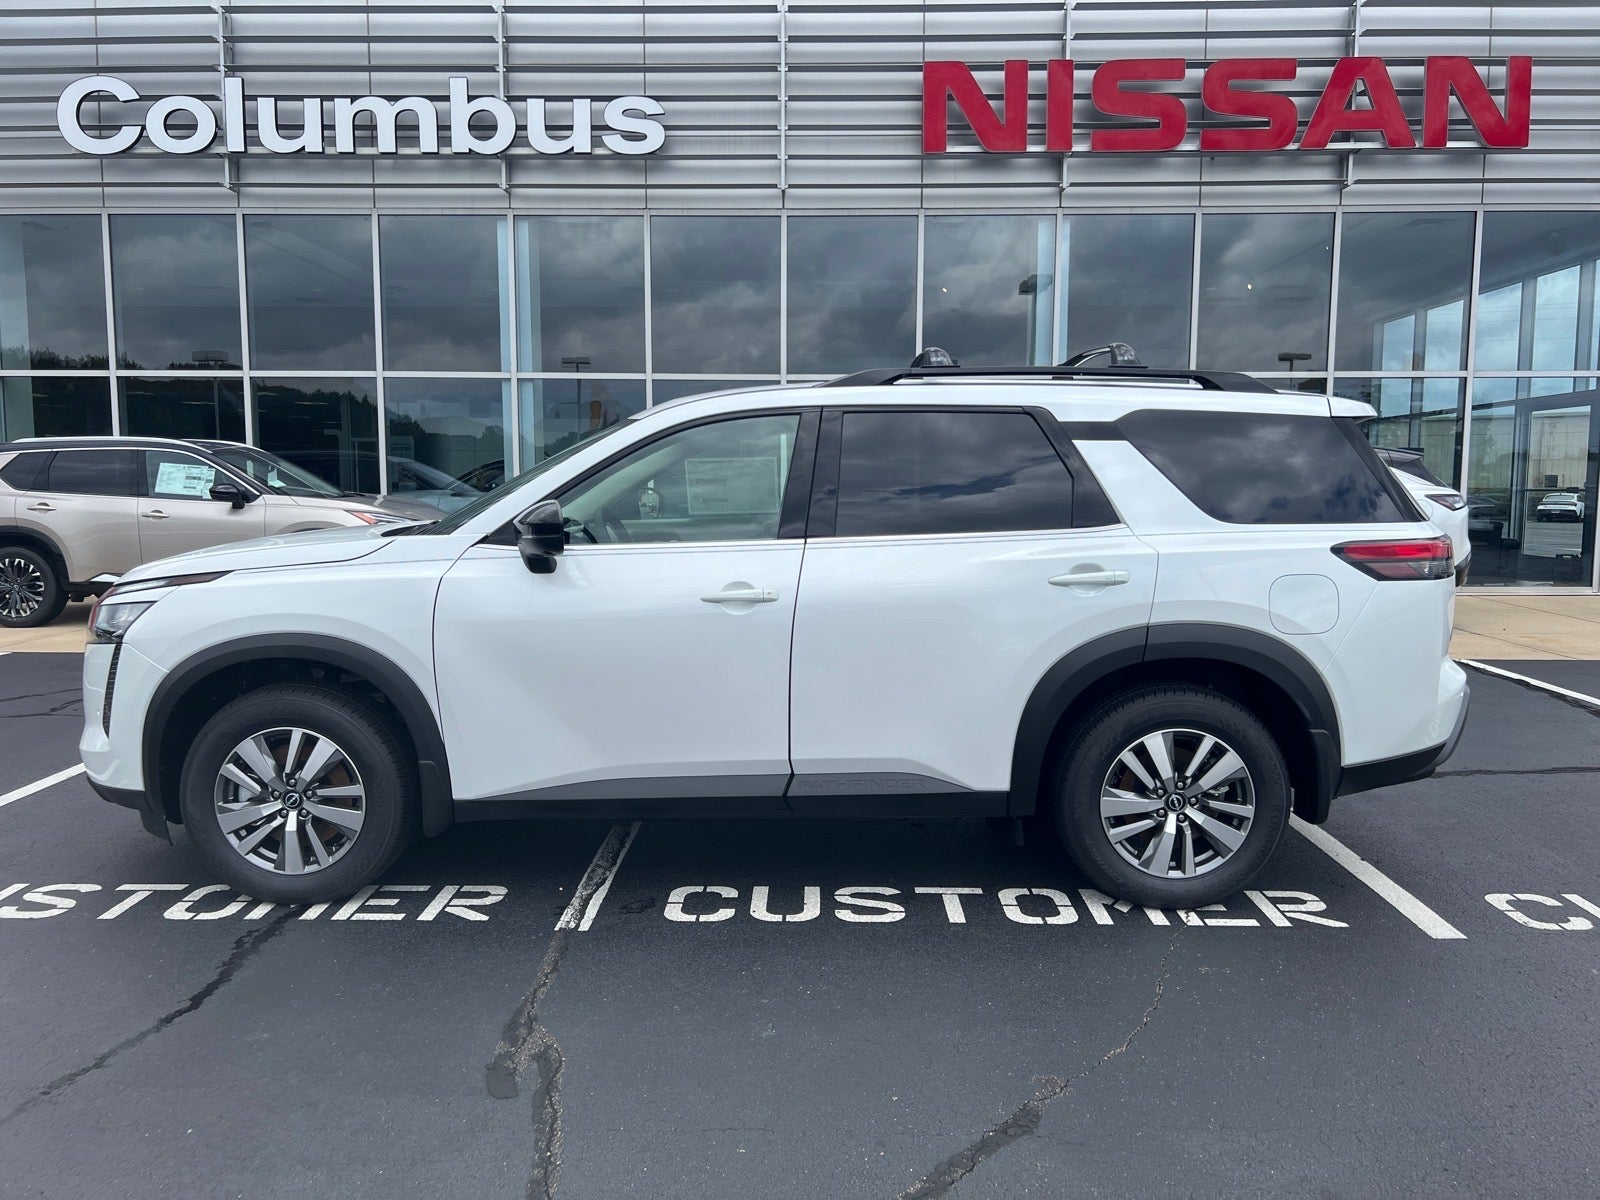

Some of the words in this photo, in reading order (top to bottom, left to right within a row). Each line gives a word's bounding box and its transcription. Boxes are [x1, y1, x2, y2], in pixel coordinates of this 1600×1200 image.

[56, 74, 667, 156] Columbus
[922, 55, 1533, 154] NISSAN
[796, 777, 927, 789] PATHFINDER
[1257, 804, 1281, 859] KUMHO
